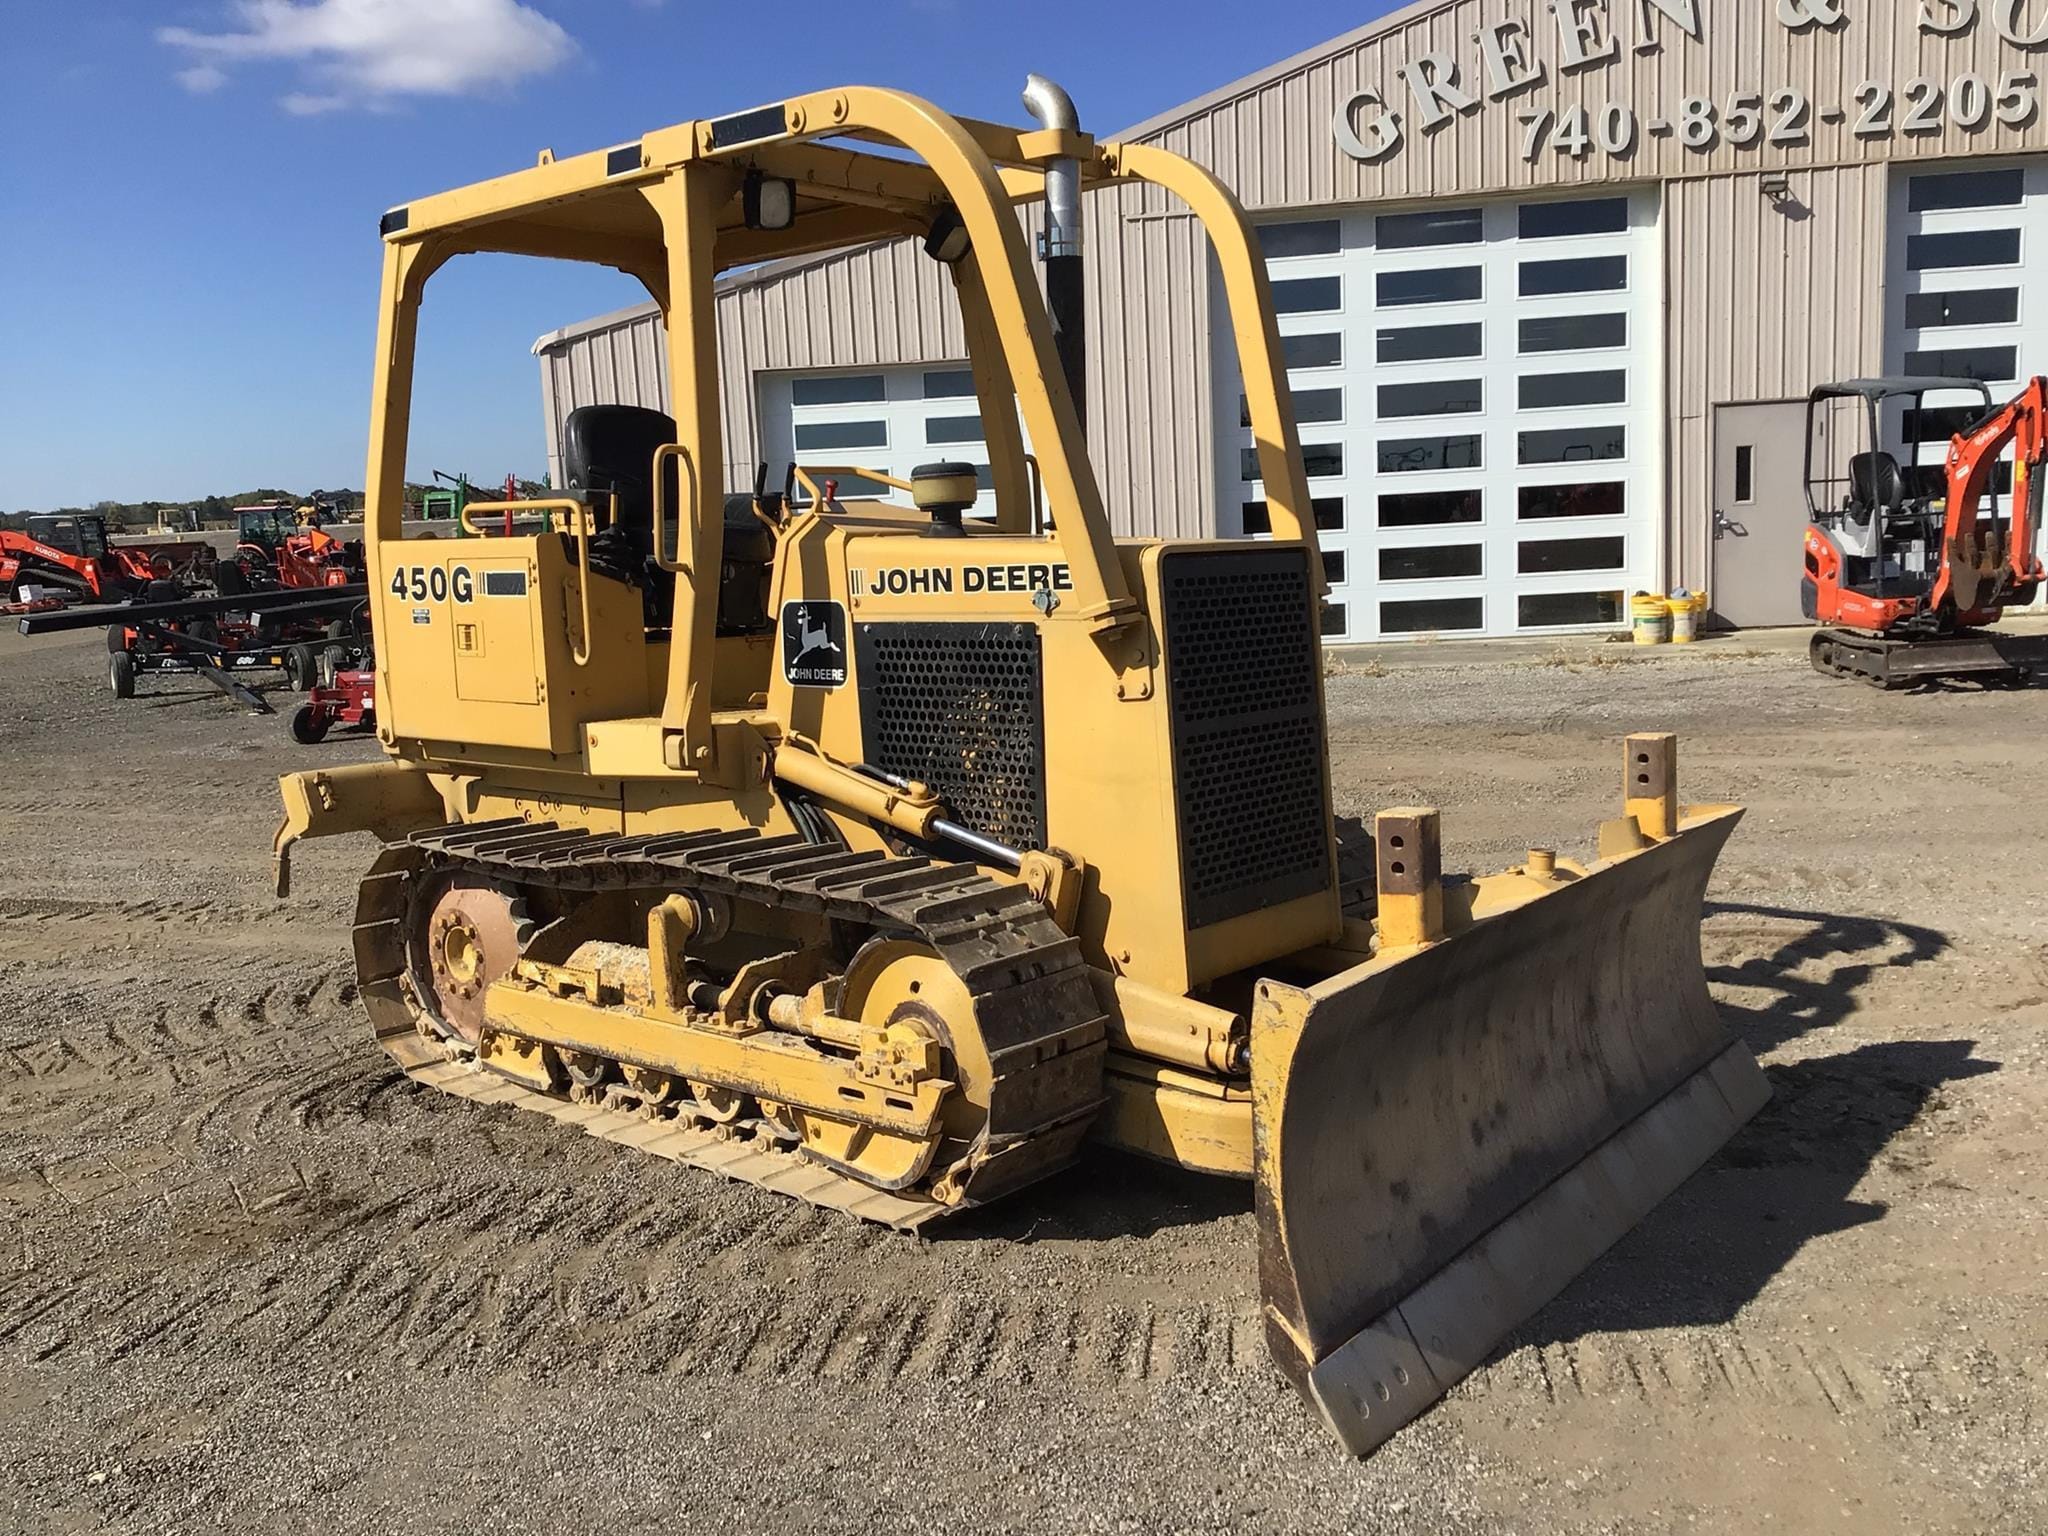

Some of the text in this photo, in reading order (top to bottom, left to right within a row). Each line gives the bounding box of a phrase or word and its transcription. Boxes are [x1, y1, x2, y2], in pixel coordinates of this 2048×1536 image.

[1333, 0, 1699, 158] GREEN
[1517, 69, 2034, 158] 740-852-2205
[34, 545, 60, 559] KUBOTA
[391, 566, 473, 603] 450G
[870, 563, 1073, 595] JOHN DEERE
[788, 667, 844, 681] JOHN DEERE
